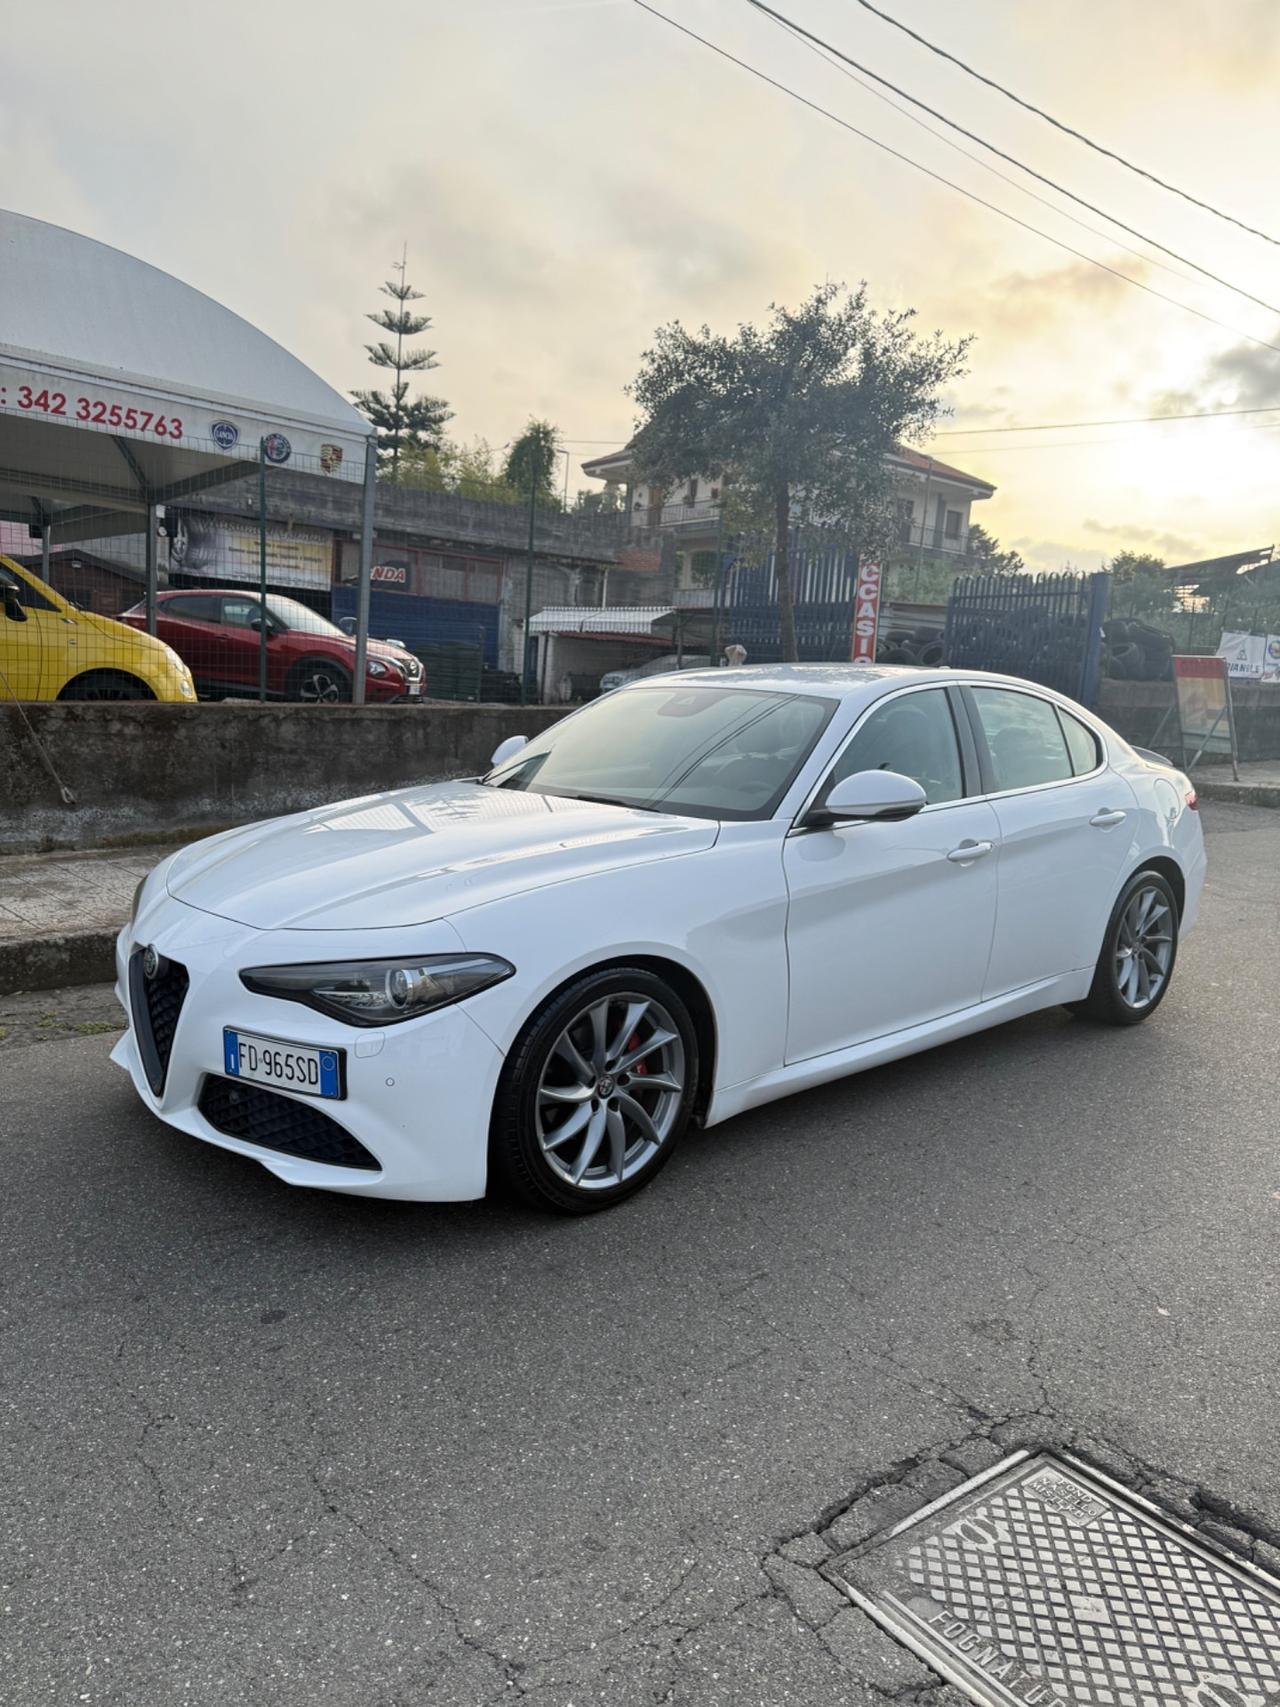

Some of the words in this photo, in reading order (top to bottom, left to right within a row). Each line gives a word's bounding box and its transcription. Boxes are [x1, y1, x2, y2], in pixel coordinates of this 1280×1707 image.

[17, 385, 67, 416] 342
[75, 397, 184, 439] 3255763
[369, 565, 406, 583] NDA
